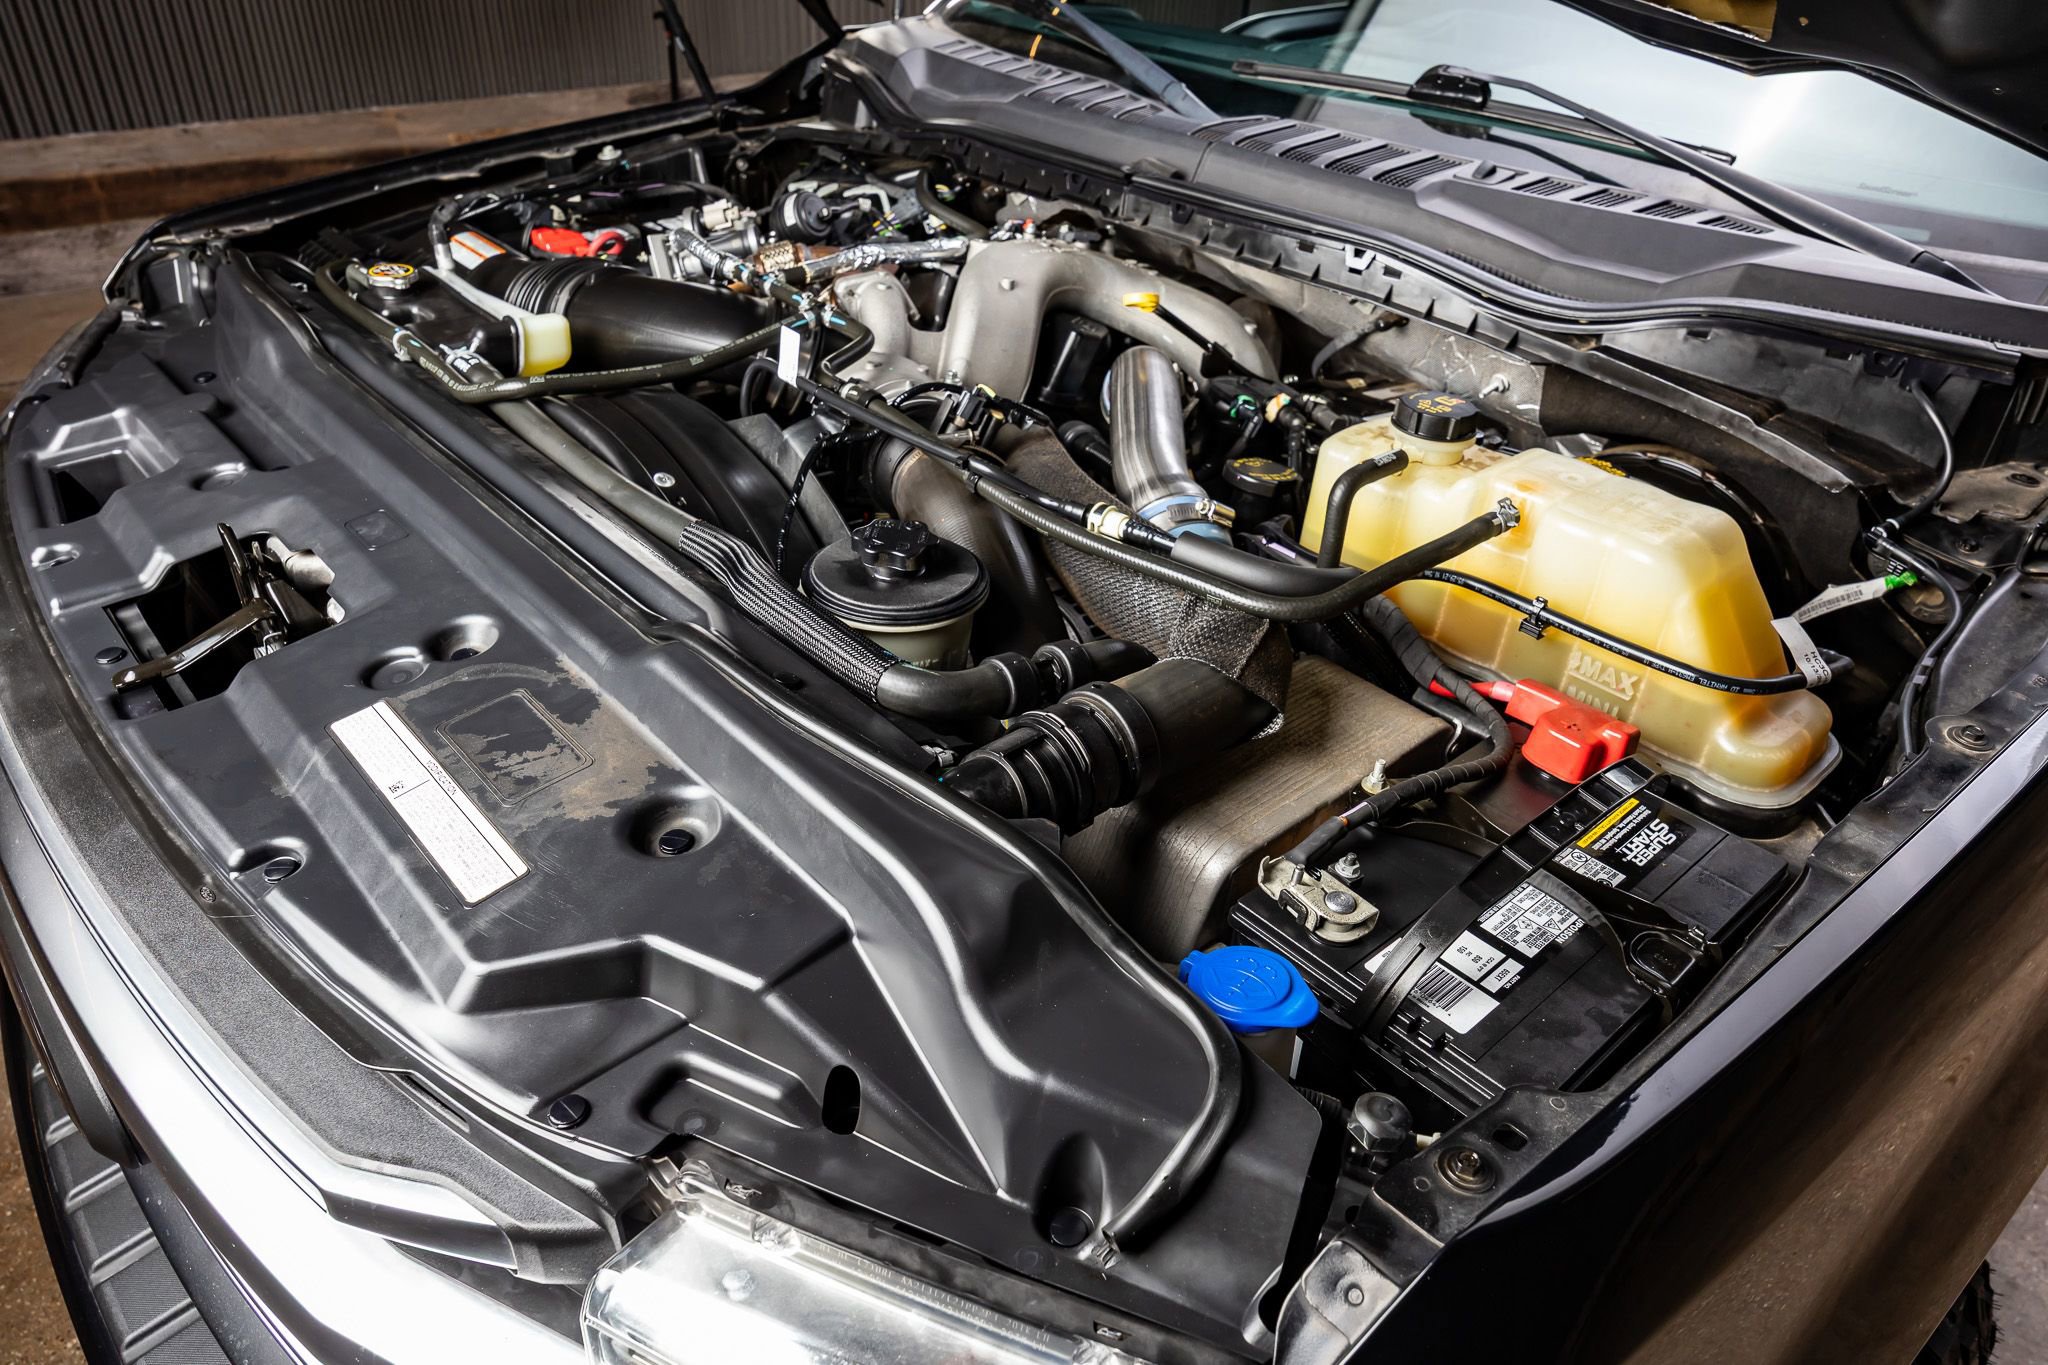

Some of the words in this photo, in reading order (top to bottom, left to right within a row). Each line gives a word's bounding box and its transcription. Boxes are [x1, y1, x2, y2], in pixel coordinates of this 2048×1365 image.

[1579, 655, 1639, 696] MAX
[1625, 818, 1670, 861] START
[1632, 829, 1677, 867] SUPER
